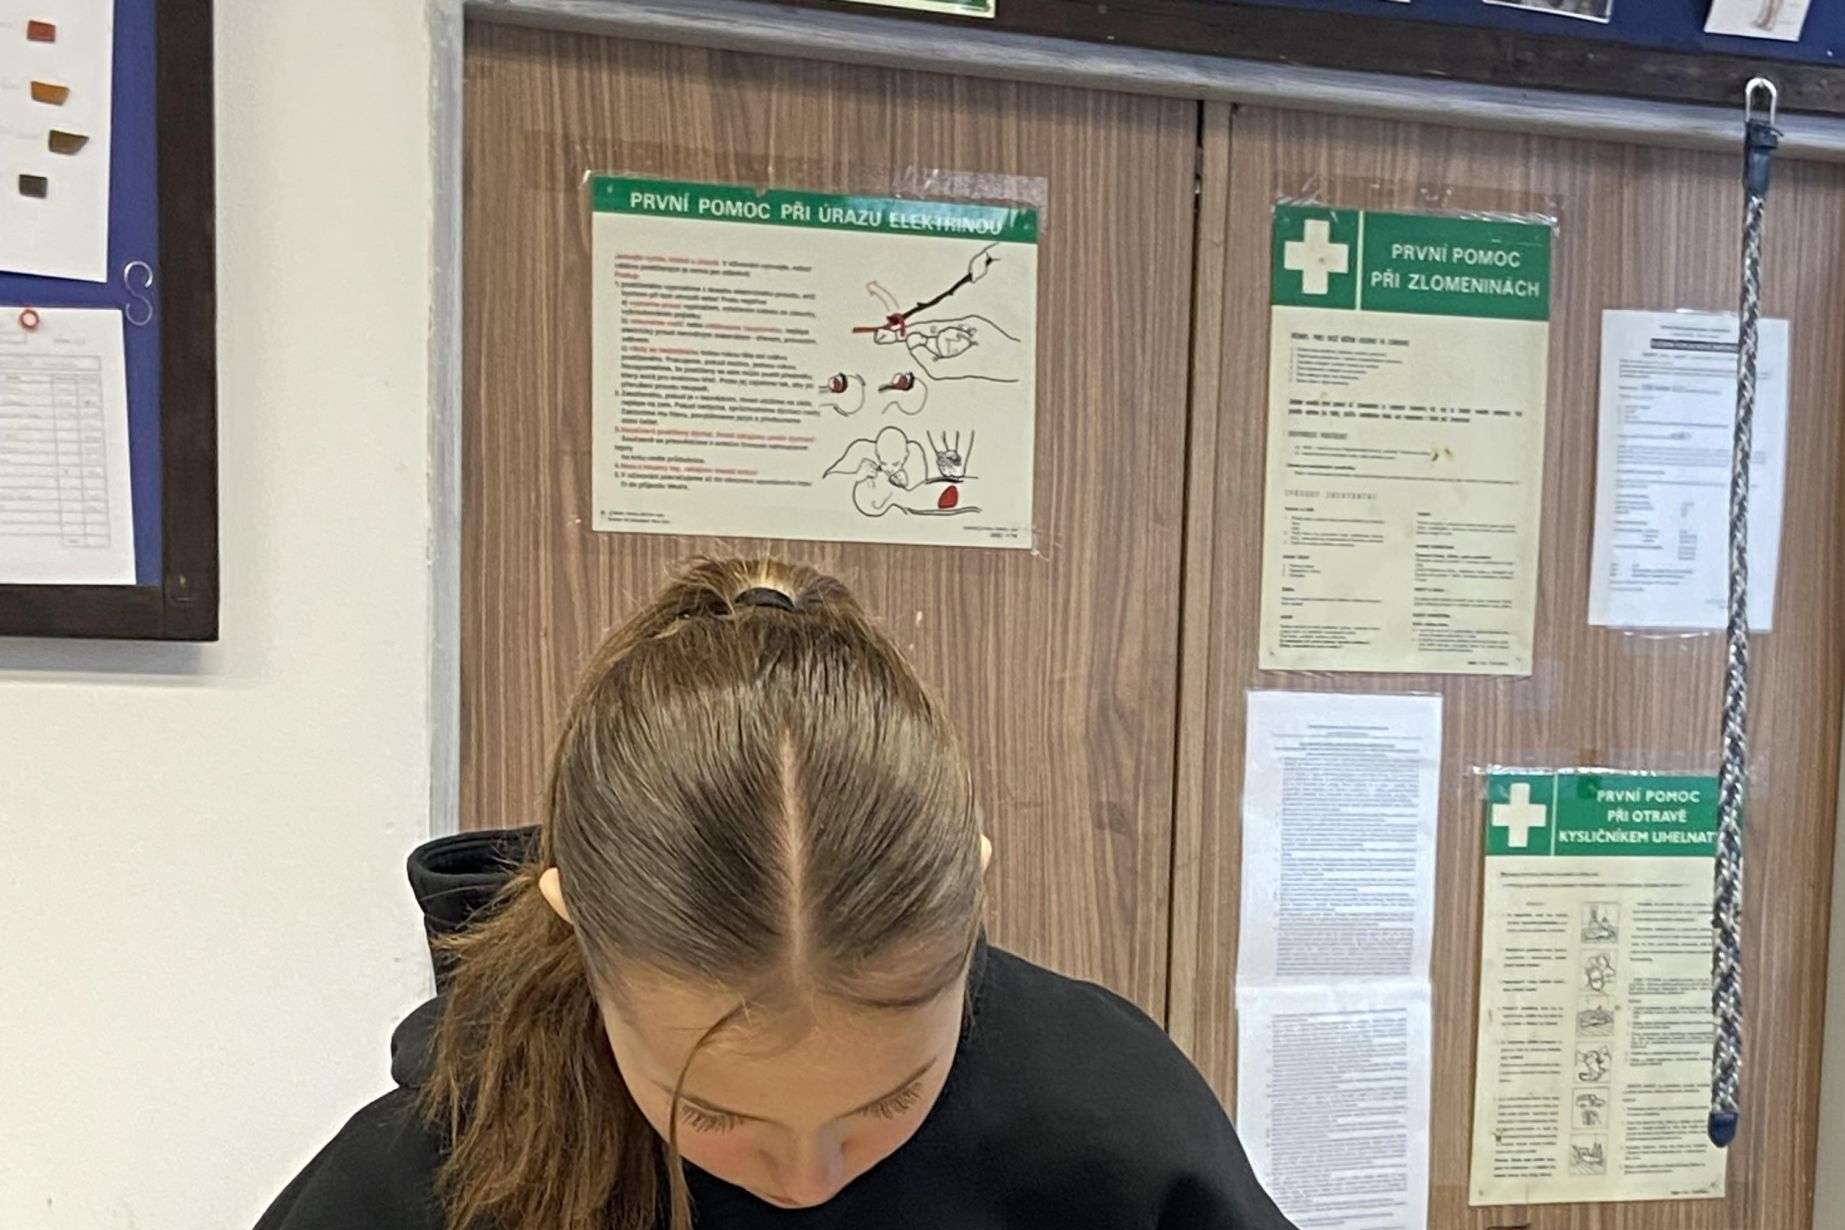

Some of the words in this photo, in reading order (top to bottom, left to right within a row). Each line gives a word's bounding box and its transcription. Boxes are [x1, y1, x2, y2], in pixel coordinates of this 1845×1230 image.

[630, 192, 690, 213] PRVNÍ
[698, 197, 771, 220] POMOC
[780, 201, 811, 222] PŘI
[818, 203, 882, 227] ÚRAZU
[1391, 242, 1449, 263] PRVNÍ
[1452, 246, 1521, 268] POMOC
[1370, 267, 1400, 289] PŘI
[1408, 273, 1540, 298] ZLOMENINÁCH
[1596, 786, 1642, 803] PRVNÍ
[1645, 789, 1701, 803] POMOC
[1606, 807, 1629, 823] PŘI
[1558, 827, 1649, 844] KYSLIČNÍKEM
[1651, 829, 1718, 844] UHELNAT
